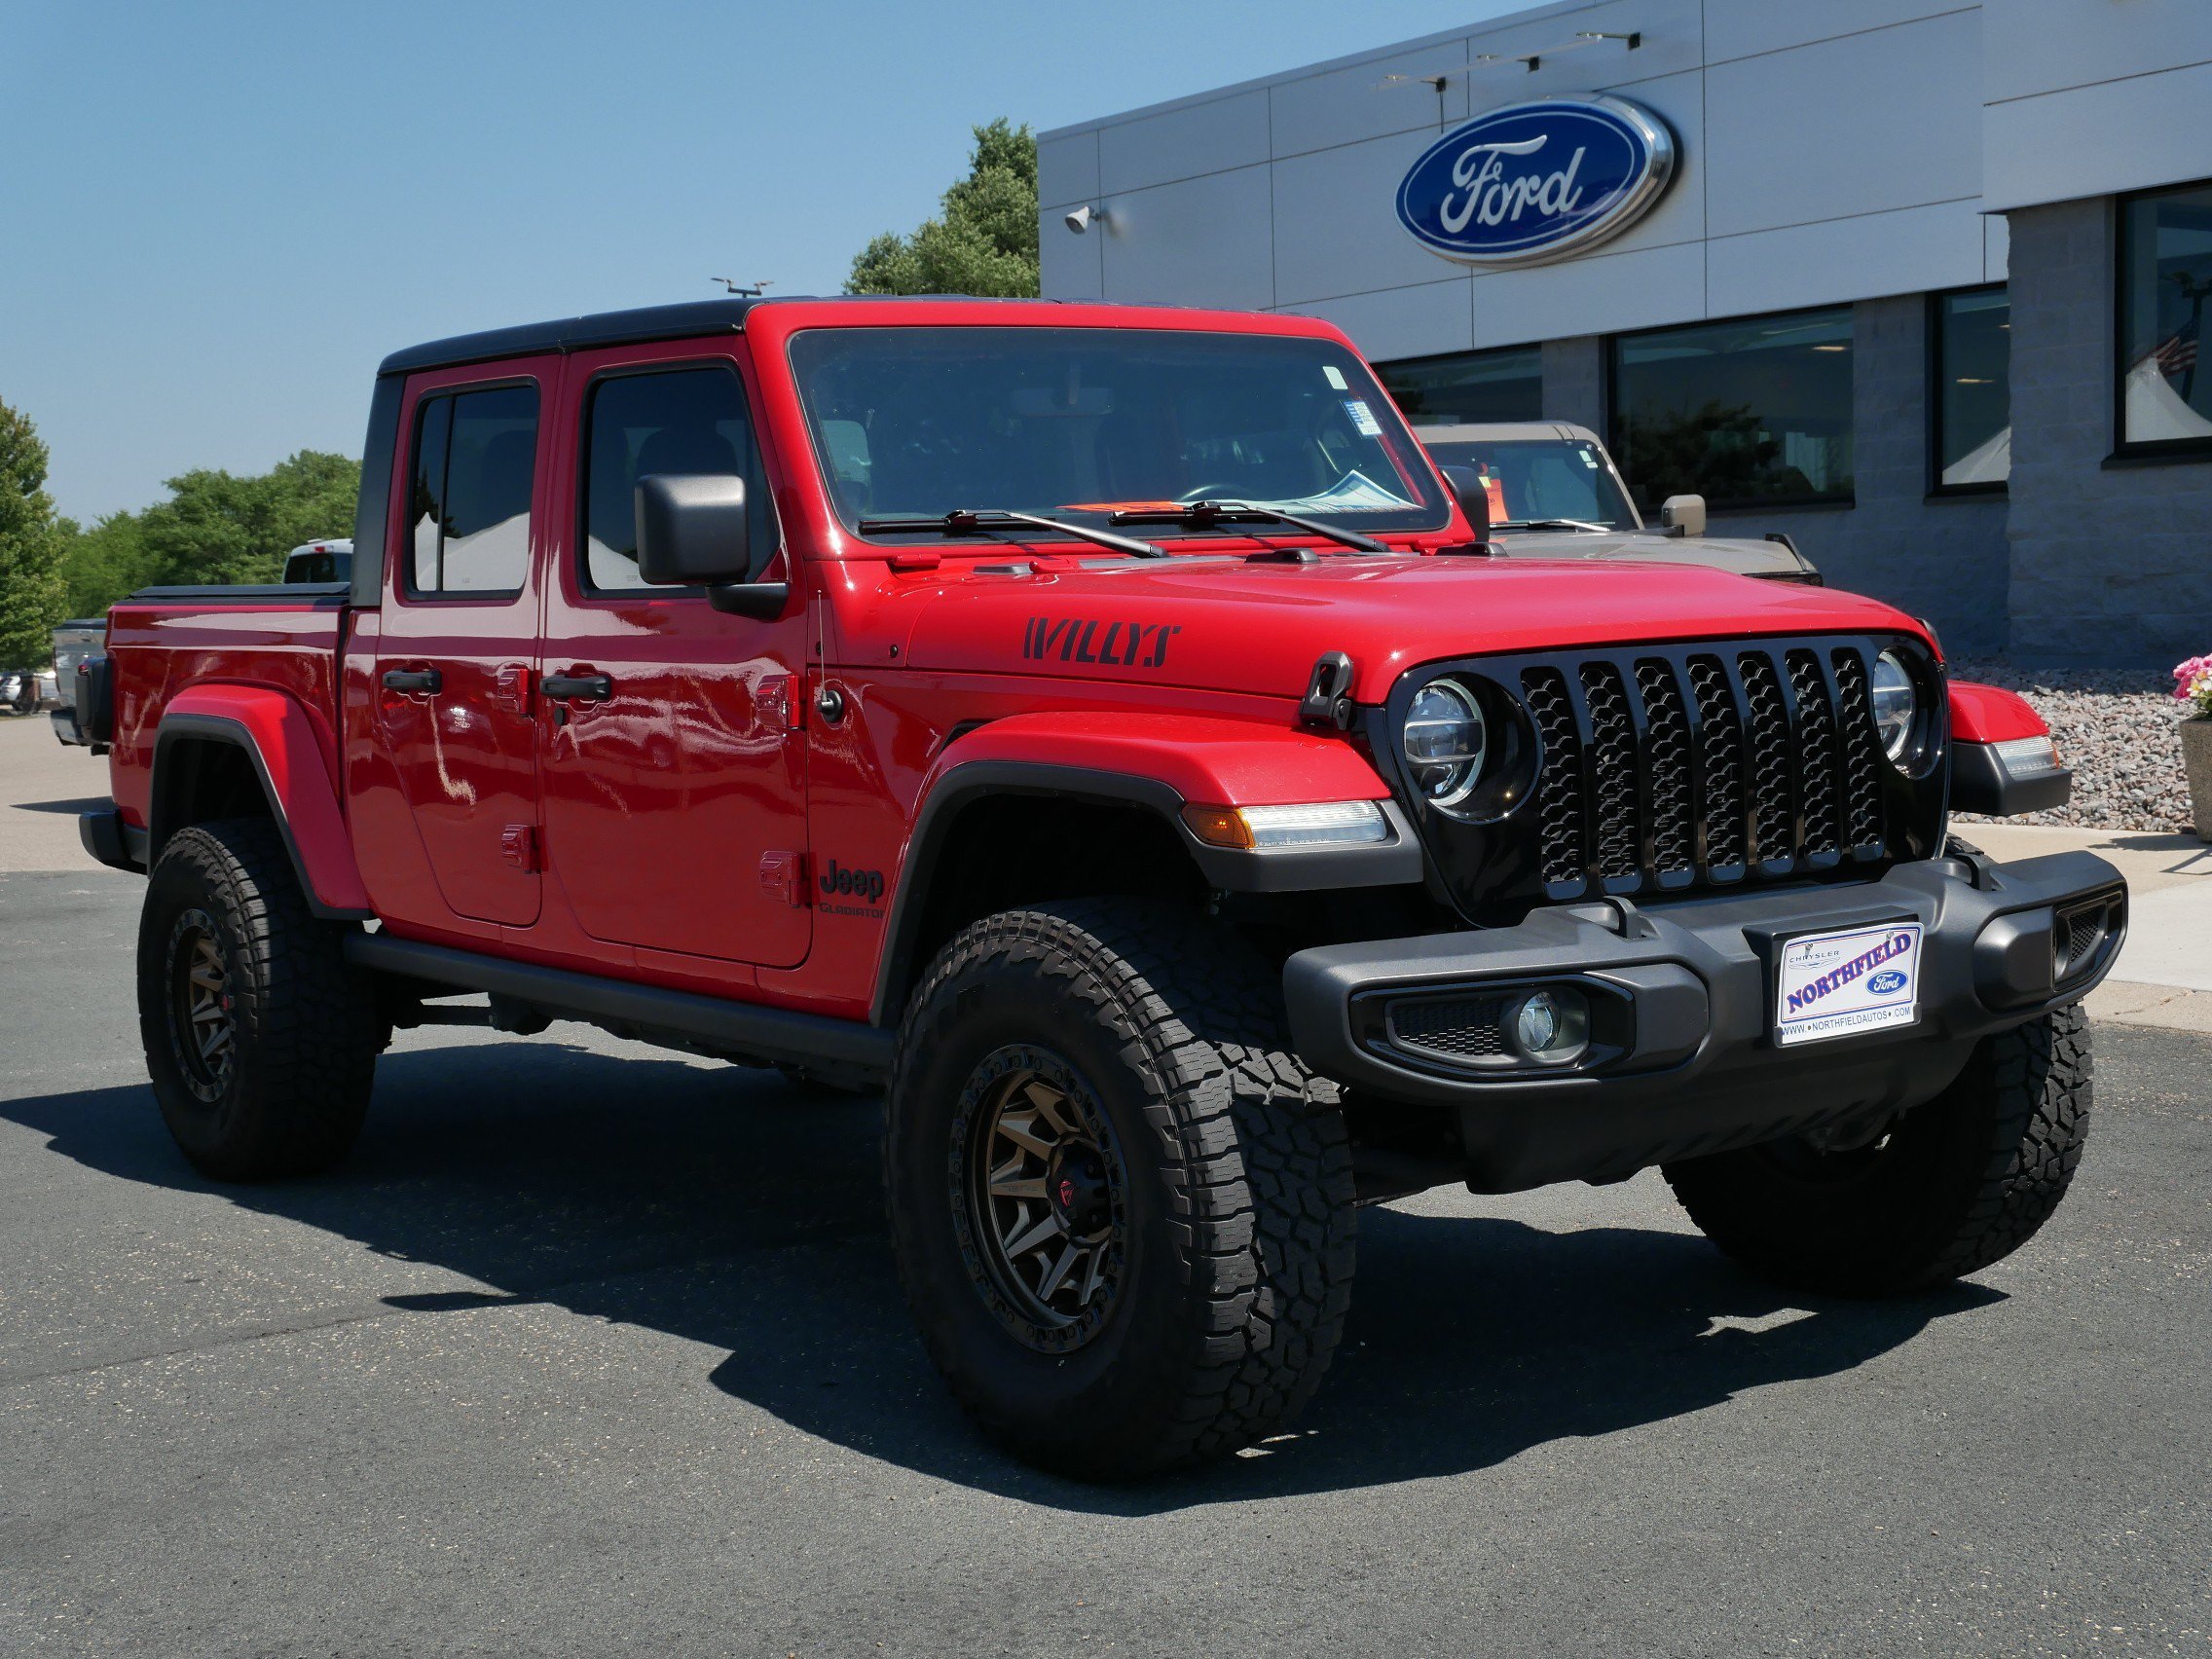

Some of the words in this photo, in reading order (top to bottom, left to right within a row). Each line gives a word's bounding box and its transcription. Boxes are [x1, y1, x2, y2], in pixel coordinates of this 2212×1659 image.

[1440, 134, 1586, 234] Ford
[1024, 616, 1183, 668] WILLYS
[820, 858, 884, 904] Jeep
[1787, 933, 1912, 1014] NORTHFIELD
[1872, 973, 1900, 992] Ford
